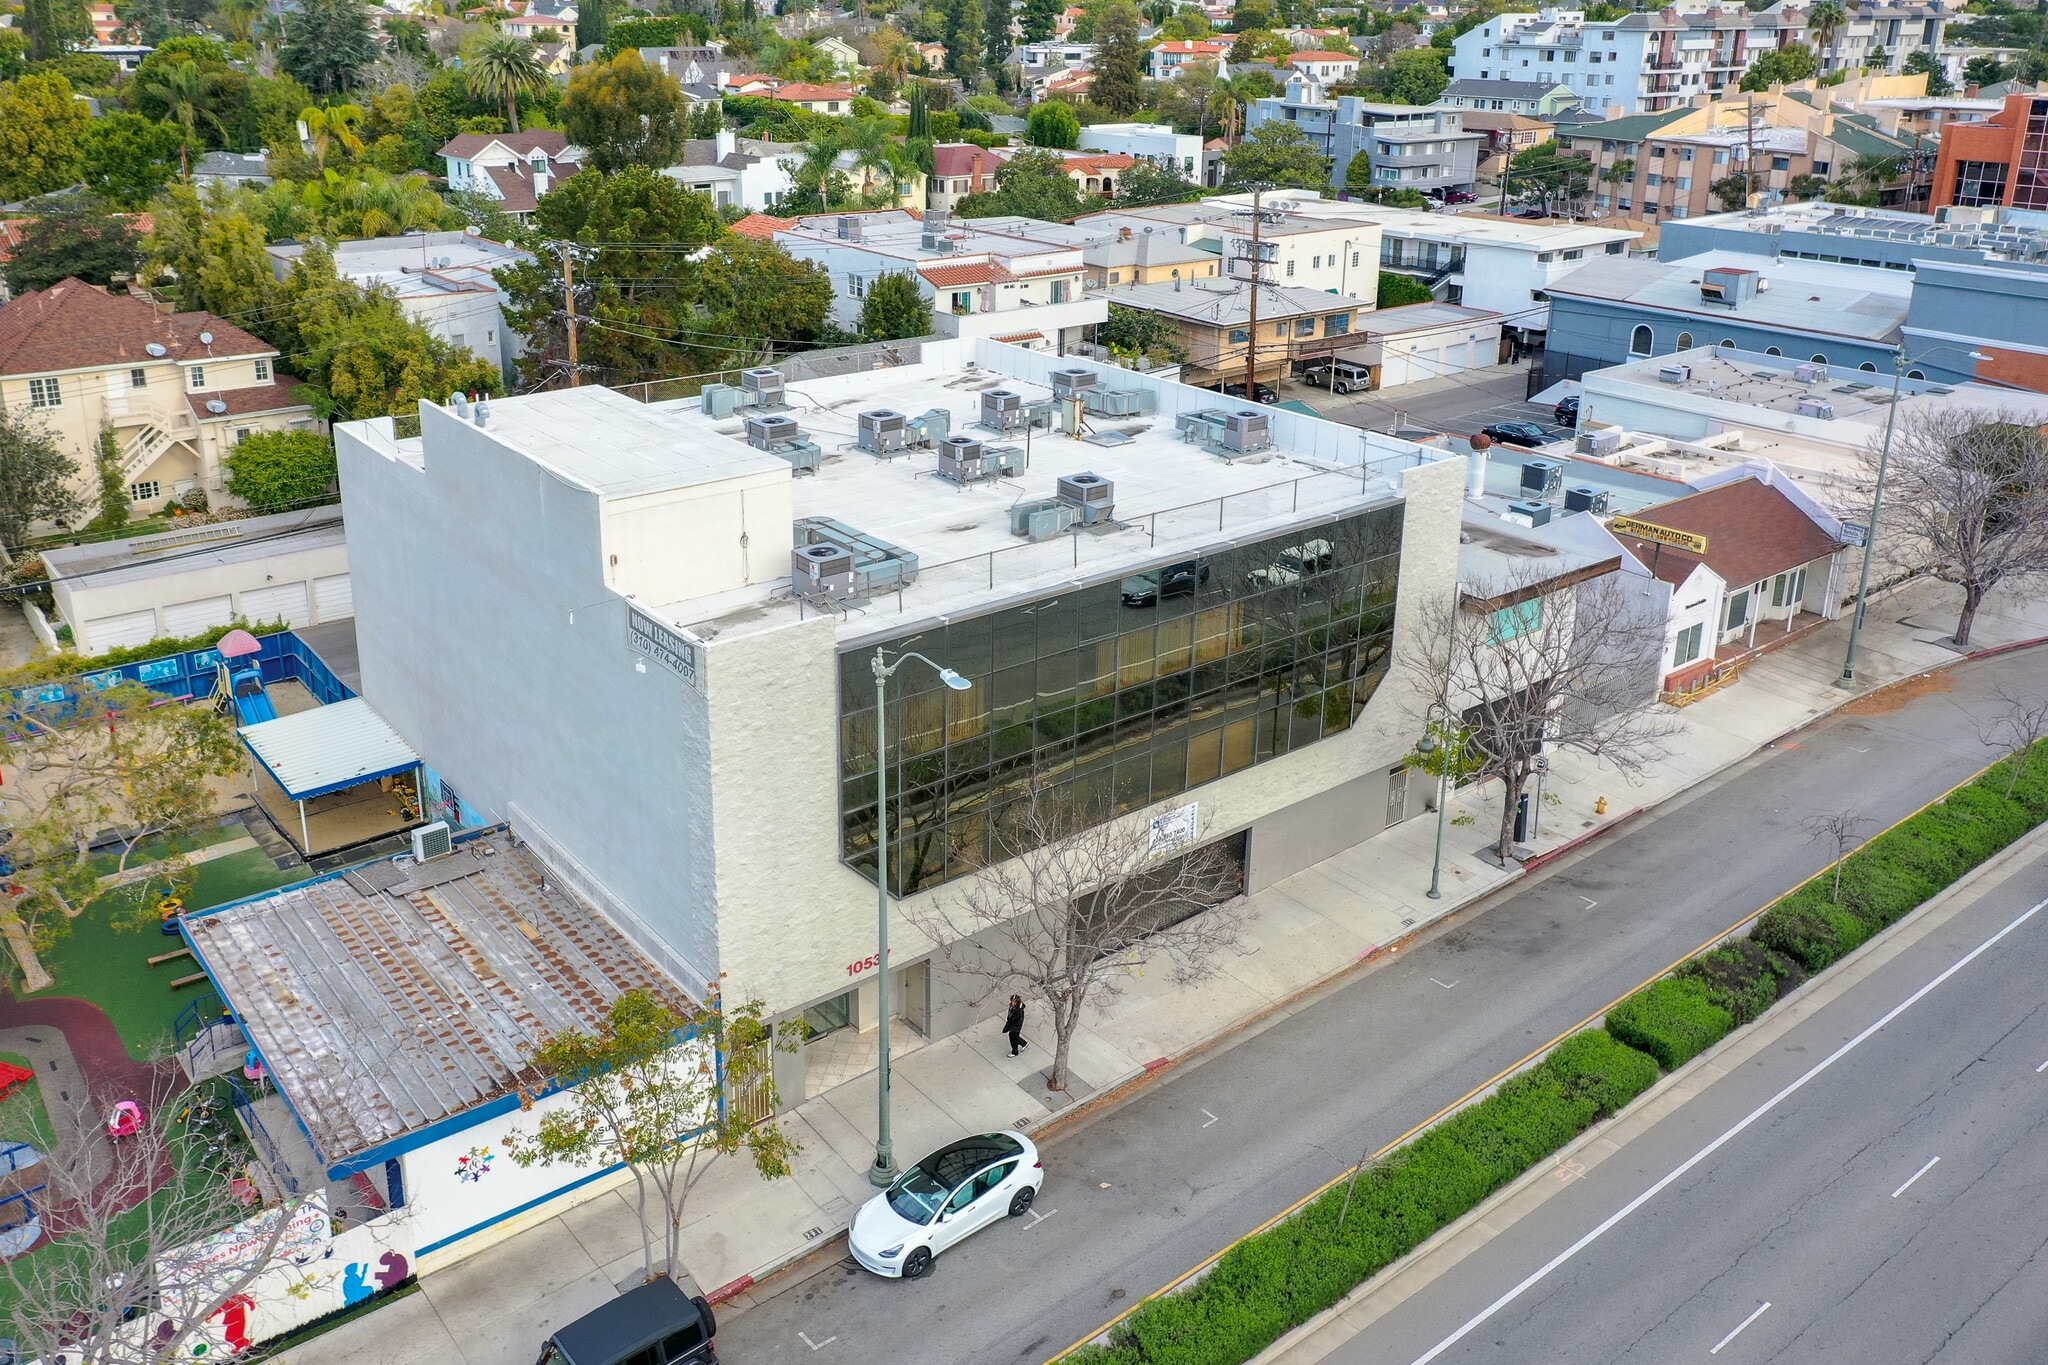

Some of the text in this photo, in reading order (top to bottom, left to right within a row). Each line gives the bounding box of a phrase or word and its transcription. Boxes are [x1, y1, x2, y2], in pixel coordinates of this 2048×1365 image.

[1626, 520, 1658, 534] GERMAN
[1660, 529, 1681, 540] AUTO
[631, 611, 692, 664] NOW LEASING
[630, 631, 695, 680] (310) 474-4007
[846, 948, 891, 976] 1053
[229, 1239, 258, 1255] Now
